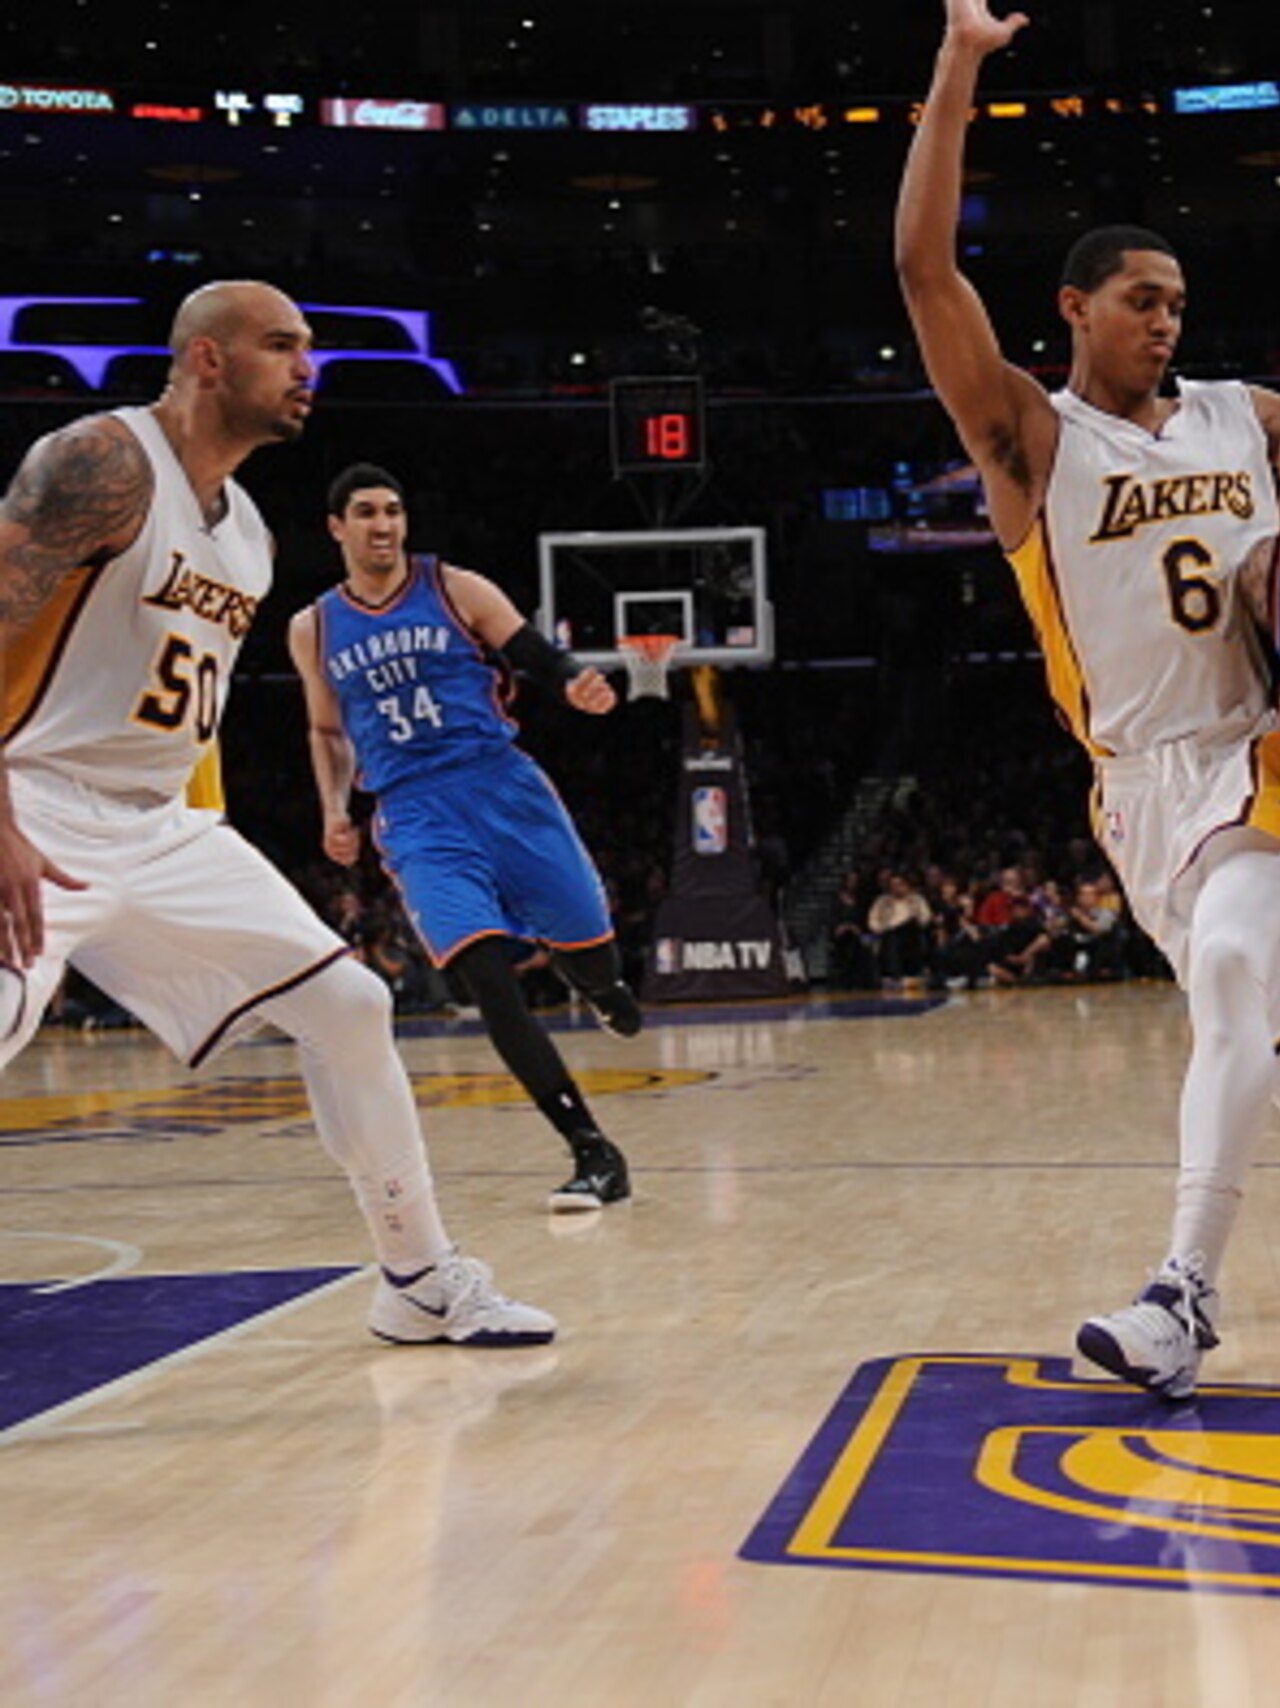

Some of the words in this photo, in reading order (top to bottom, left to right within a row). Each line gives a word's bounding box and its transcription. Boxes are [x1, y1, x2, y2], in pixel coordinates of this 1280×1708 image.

[20, 87, 113, 110] TOYOTA
[483, 106, 569, 126] DELTA
[587, 106, 688, 130] STAPLES
[646, 414, 687, 459] 18
[1088, 471, 1254, 544] LAKERS
[1162, 536, 1221, 636] 6
[328, 626, 450, 680] OKLAHOMA
[366, 657, 417, 693] CITY
[129, 632, 217, 745] 50
[377, 686, 443, 743] 34
[683, 941, 736, 970] NBA
[737, 941, 771, 970] TV
